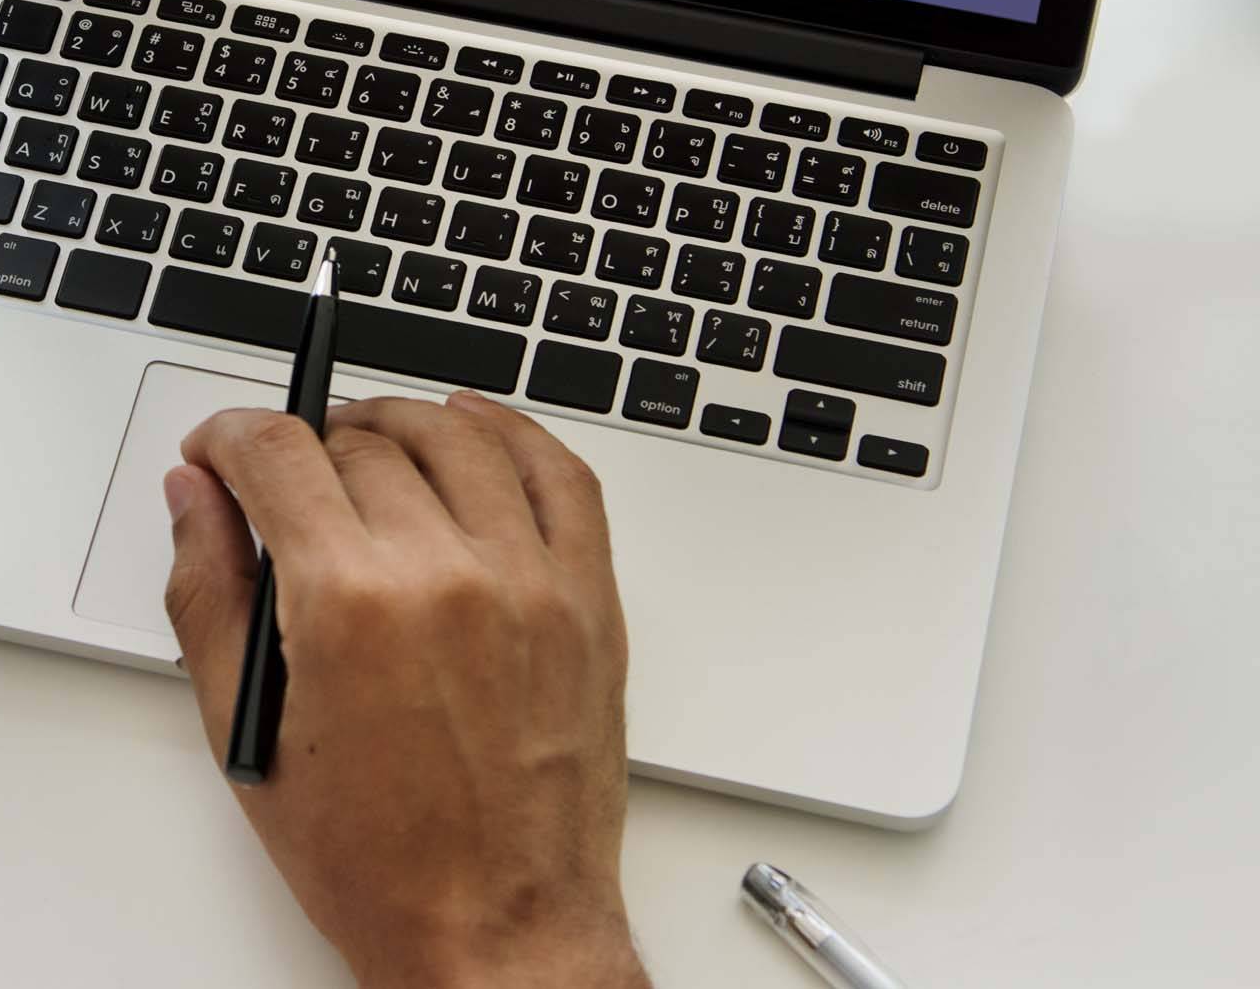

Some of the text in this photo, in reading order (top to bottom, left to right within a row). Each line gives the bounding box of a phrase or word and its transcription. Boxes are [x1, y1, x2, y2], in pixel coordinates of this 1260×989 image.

[2, 22, 8, 35] 1
[71, 36, 83, 49] 2
[143, 50, 154, 63] 3
[428, 55, 438, 63] F6
[215, 64, 226, 77] 4
[286, 76, 299, 90] 5
[18, 83, 34, 98] Q
[359, 91, 369, 103] 6
[90, 96, 110, 112] W
[432, 103, 444, 117] 7
[160, 110, 172, 125] E
[729, 111, 743, 119] F10
[232, 124, 246, 139] R
[505, 118, 516, 131] 8
[808, 125, 820, 133] F11
[309, 138, 319, 152] T
[579, 132, 590, 144] 9
[884, 139, 898, 148] F12
[15, 142, 30, 157] A
[653, 145, 664, 158] 0
[88, 155, 100, 169] S
[381, 151, 394, 166] Y
[161, 169, 176, 183] D
[453, 165, 469, 180] U
[233, 183, 246, 196] F
[526, 179, 532, 192] I
[309, 198, 324, 212] G
[601, 194, 617, 209] O
[921, 199, 960, 214] delete
[33, 205, 48, 220] Z
[381, 211, 398, 228] H
[675, 208, 689, 221] P
[106, 219, 122, 234] X
[455, 226, 466, 240] J
[4, 242, 16, 250] alt
[181, 234, 195, 248] C
[530, 240, 545, 256] K
[257, 247, 270, 262] V
[604, 254, 615, 269] L
[403, 277, 419, 293] N
[477, 291, 497, 308] M
[916, 297, 944, 306] enter
[901, 319, 938, 332] return
[675, 373, 688, 381] alt
[897, 379, 926, 392] shift
[640, 400, 681, 415] option
